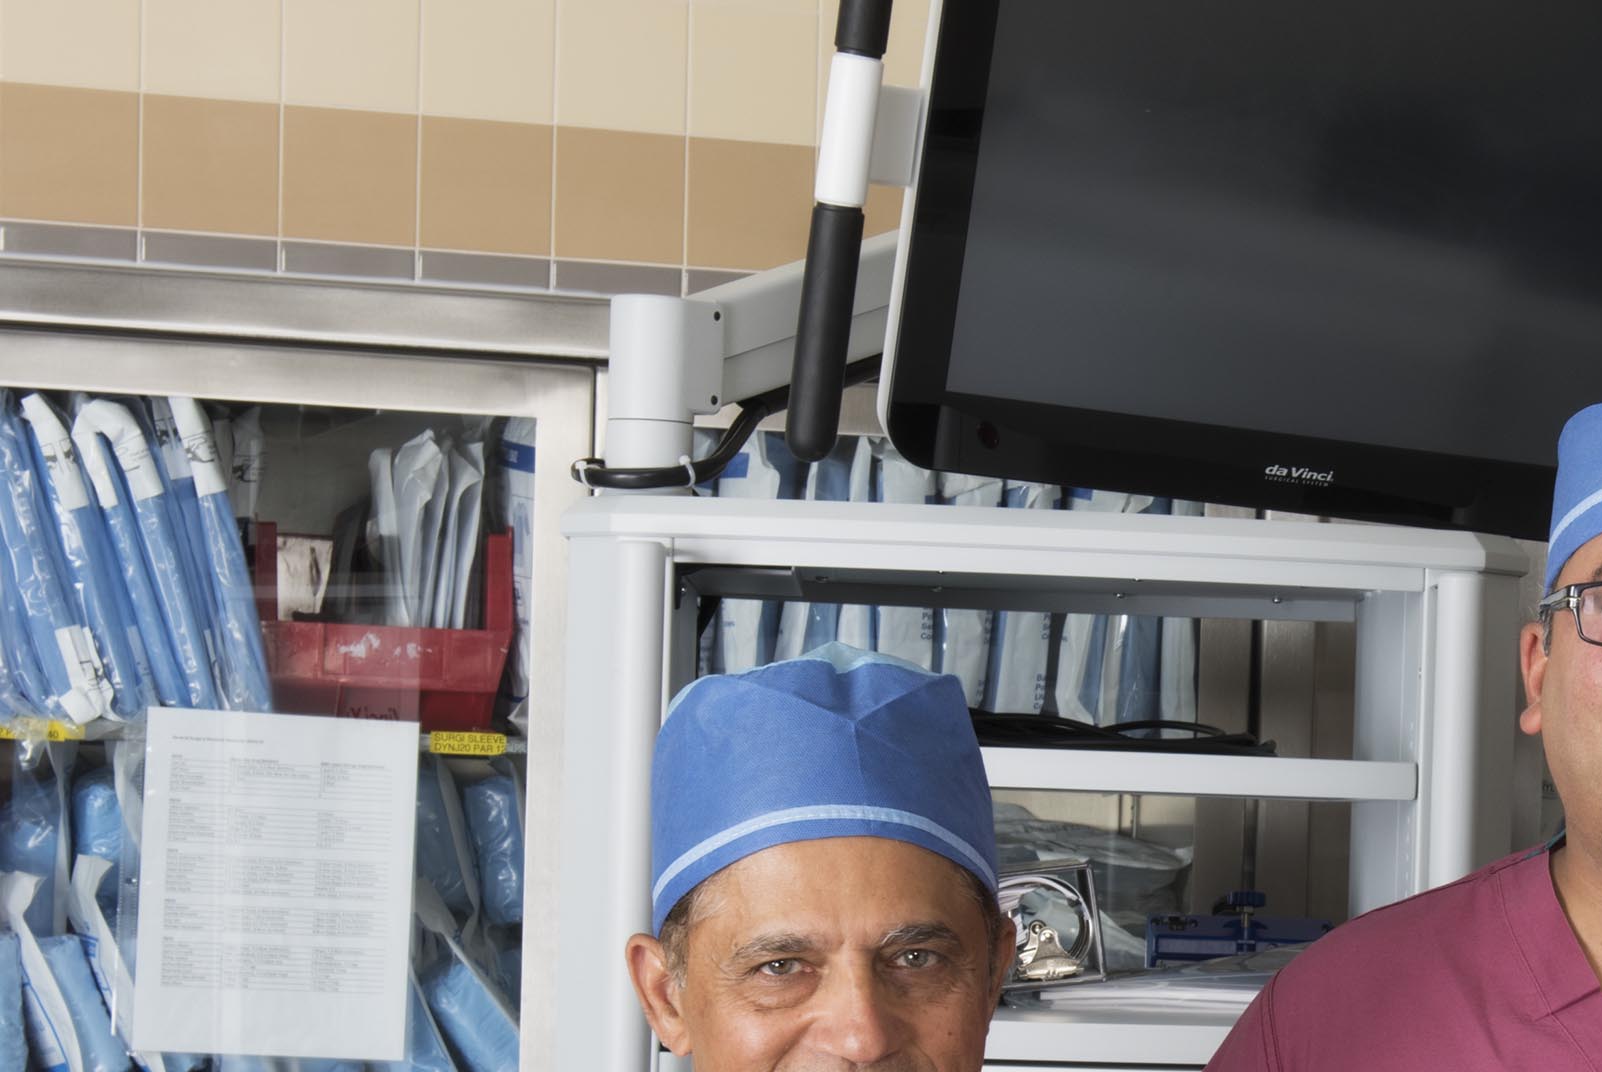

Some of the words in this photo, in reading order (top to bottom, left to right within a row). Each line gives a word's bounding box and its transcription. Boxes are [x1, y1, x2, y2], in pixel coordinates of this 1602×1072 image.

[1264, 464, 1288, 477] da
[1291, 466, 1334, 482] Vinci
[434, 732, 464, 742] SURGI
[473, 744, 493, 753] PAR
